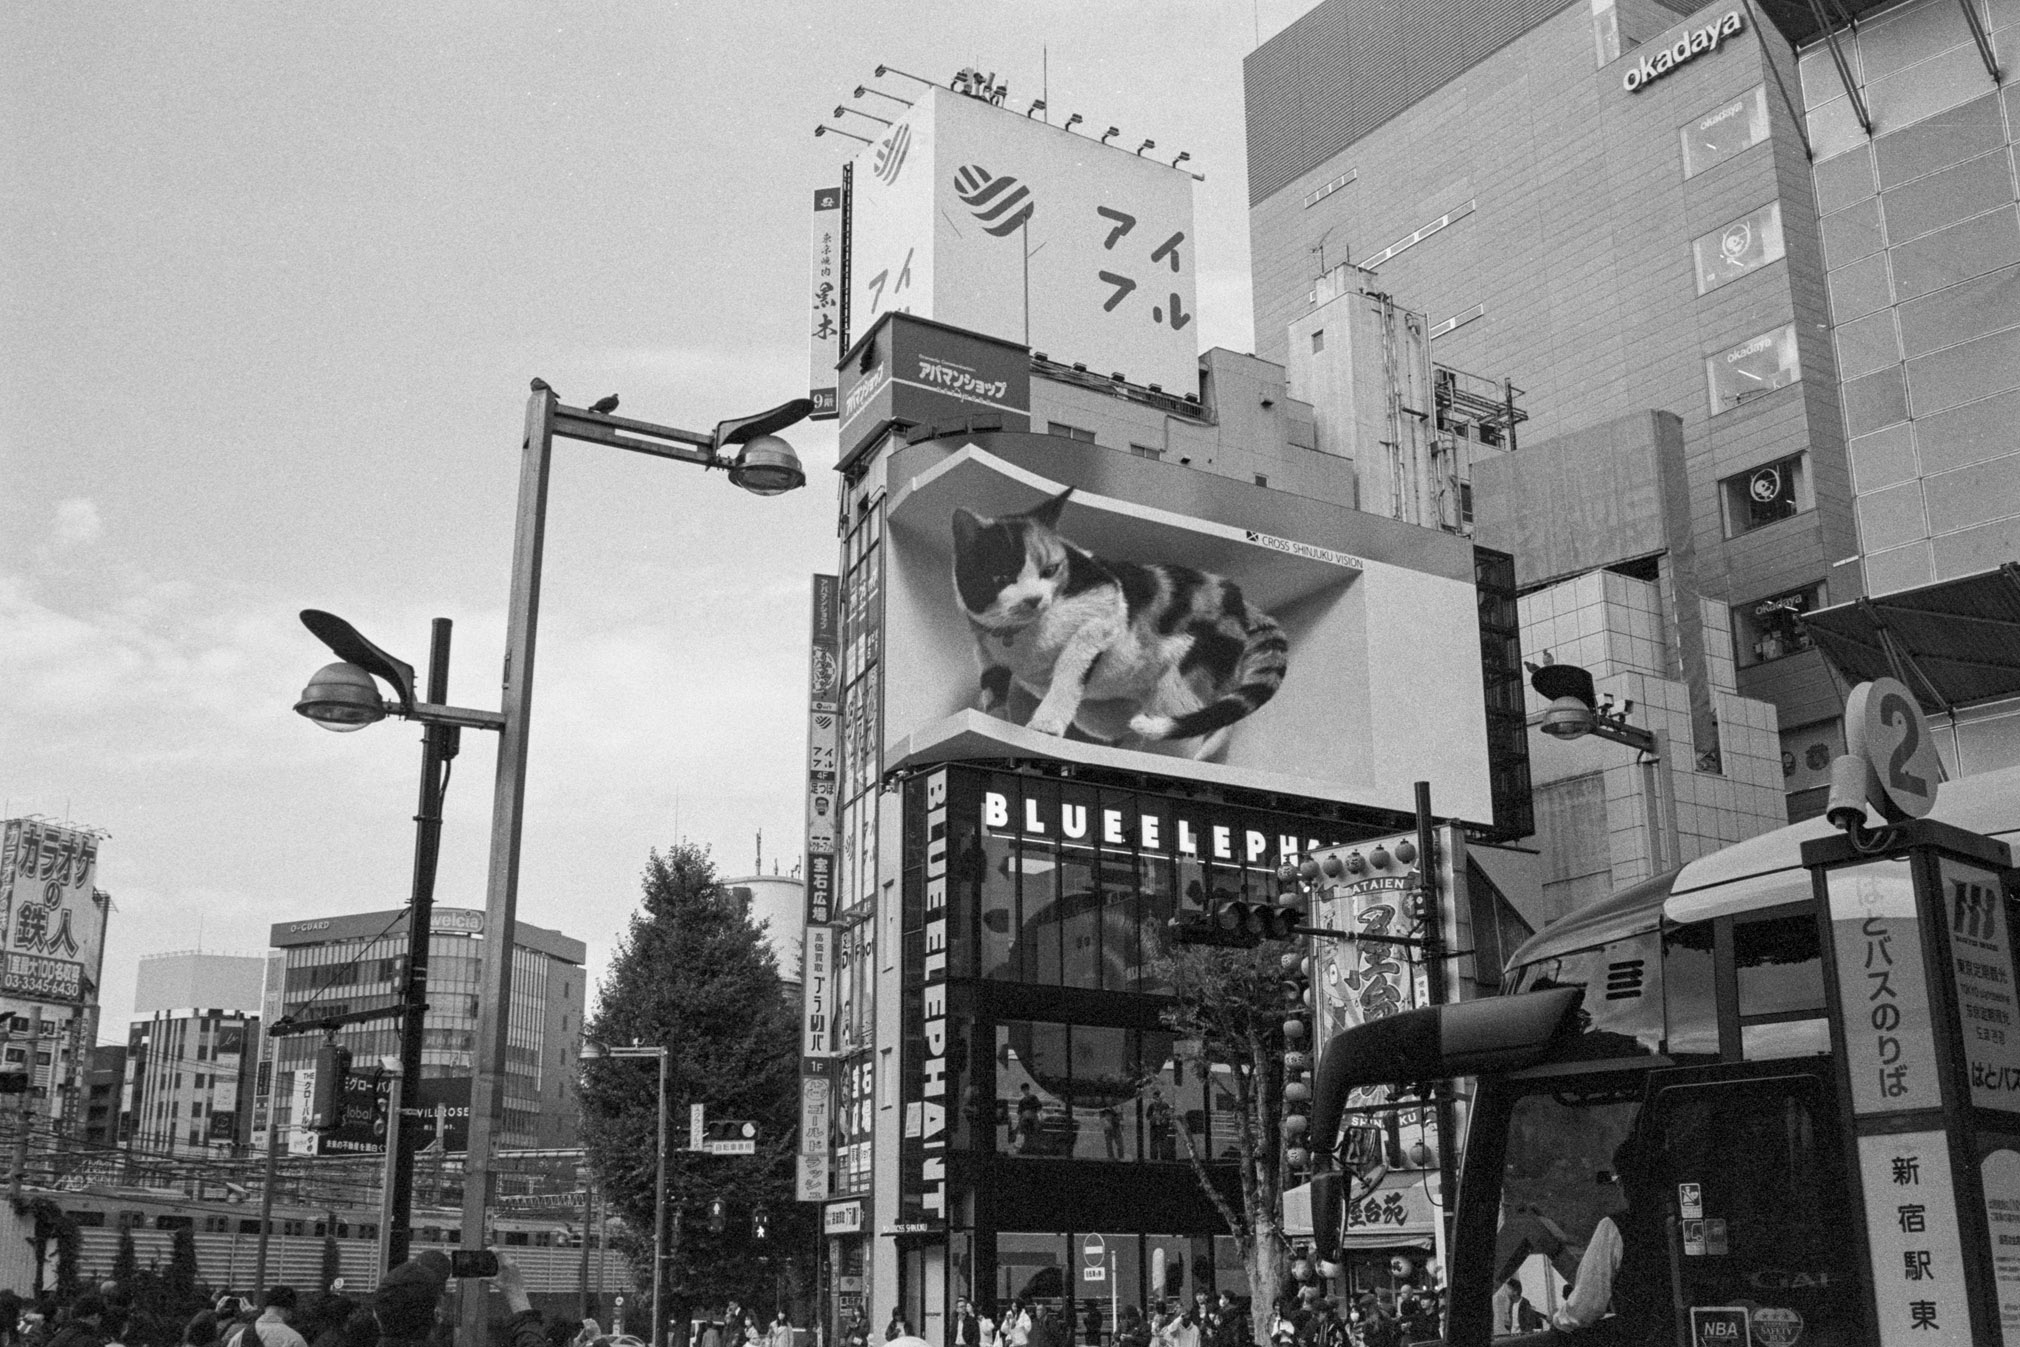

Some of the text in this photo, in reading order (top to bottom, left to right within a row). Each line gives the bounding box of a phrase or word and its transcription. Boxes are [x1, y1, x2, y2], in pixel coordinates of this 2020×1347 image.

[1623, 11, 1743, 91] okadaya
[1700, 102, 1743, 130] okadaya
[811, 281, 838, 341] 黒木
[1727, 338, 1772, 363] okadaya
[919, 361, 1007, 399] アパマンショップ
[1261, 535, 1364, 570] CROSS SHINJUKU VISION
[1755, 593, 1802, 615] okadaya
[1880, 692, 1928, 799] 2
[816, 771, 829, 780] 4F
[810, 782, 834, 795] 足つぼ
[18, 823, 97, 890] カラオケ
[43, 878, 62, 912] の
[812, 857, 828, 922] 宝石広場
[1352, 878, 1405, 895] ATAIEN
[14, 900, 79, 959] 鉄人
[290, 920, 330, 933] O-GUARD
[430, 909, 479, 929] welcia
[4, 973, 80, 997] 03-3345-6430
[303, 1072, 315, 1080] THE
[811, 1060, 824, 1072] 1F
[349, 1077, 391, 1094] グローバ
[1351, 1112, 1417, 1128] SHINKU
[326, 1139, 387, 1153] 未来の不動産を面白く
[1892, 1156, 1941, 1331] 新宿駅東
[1704, 1322, 1739, 1337] NBA
